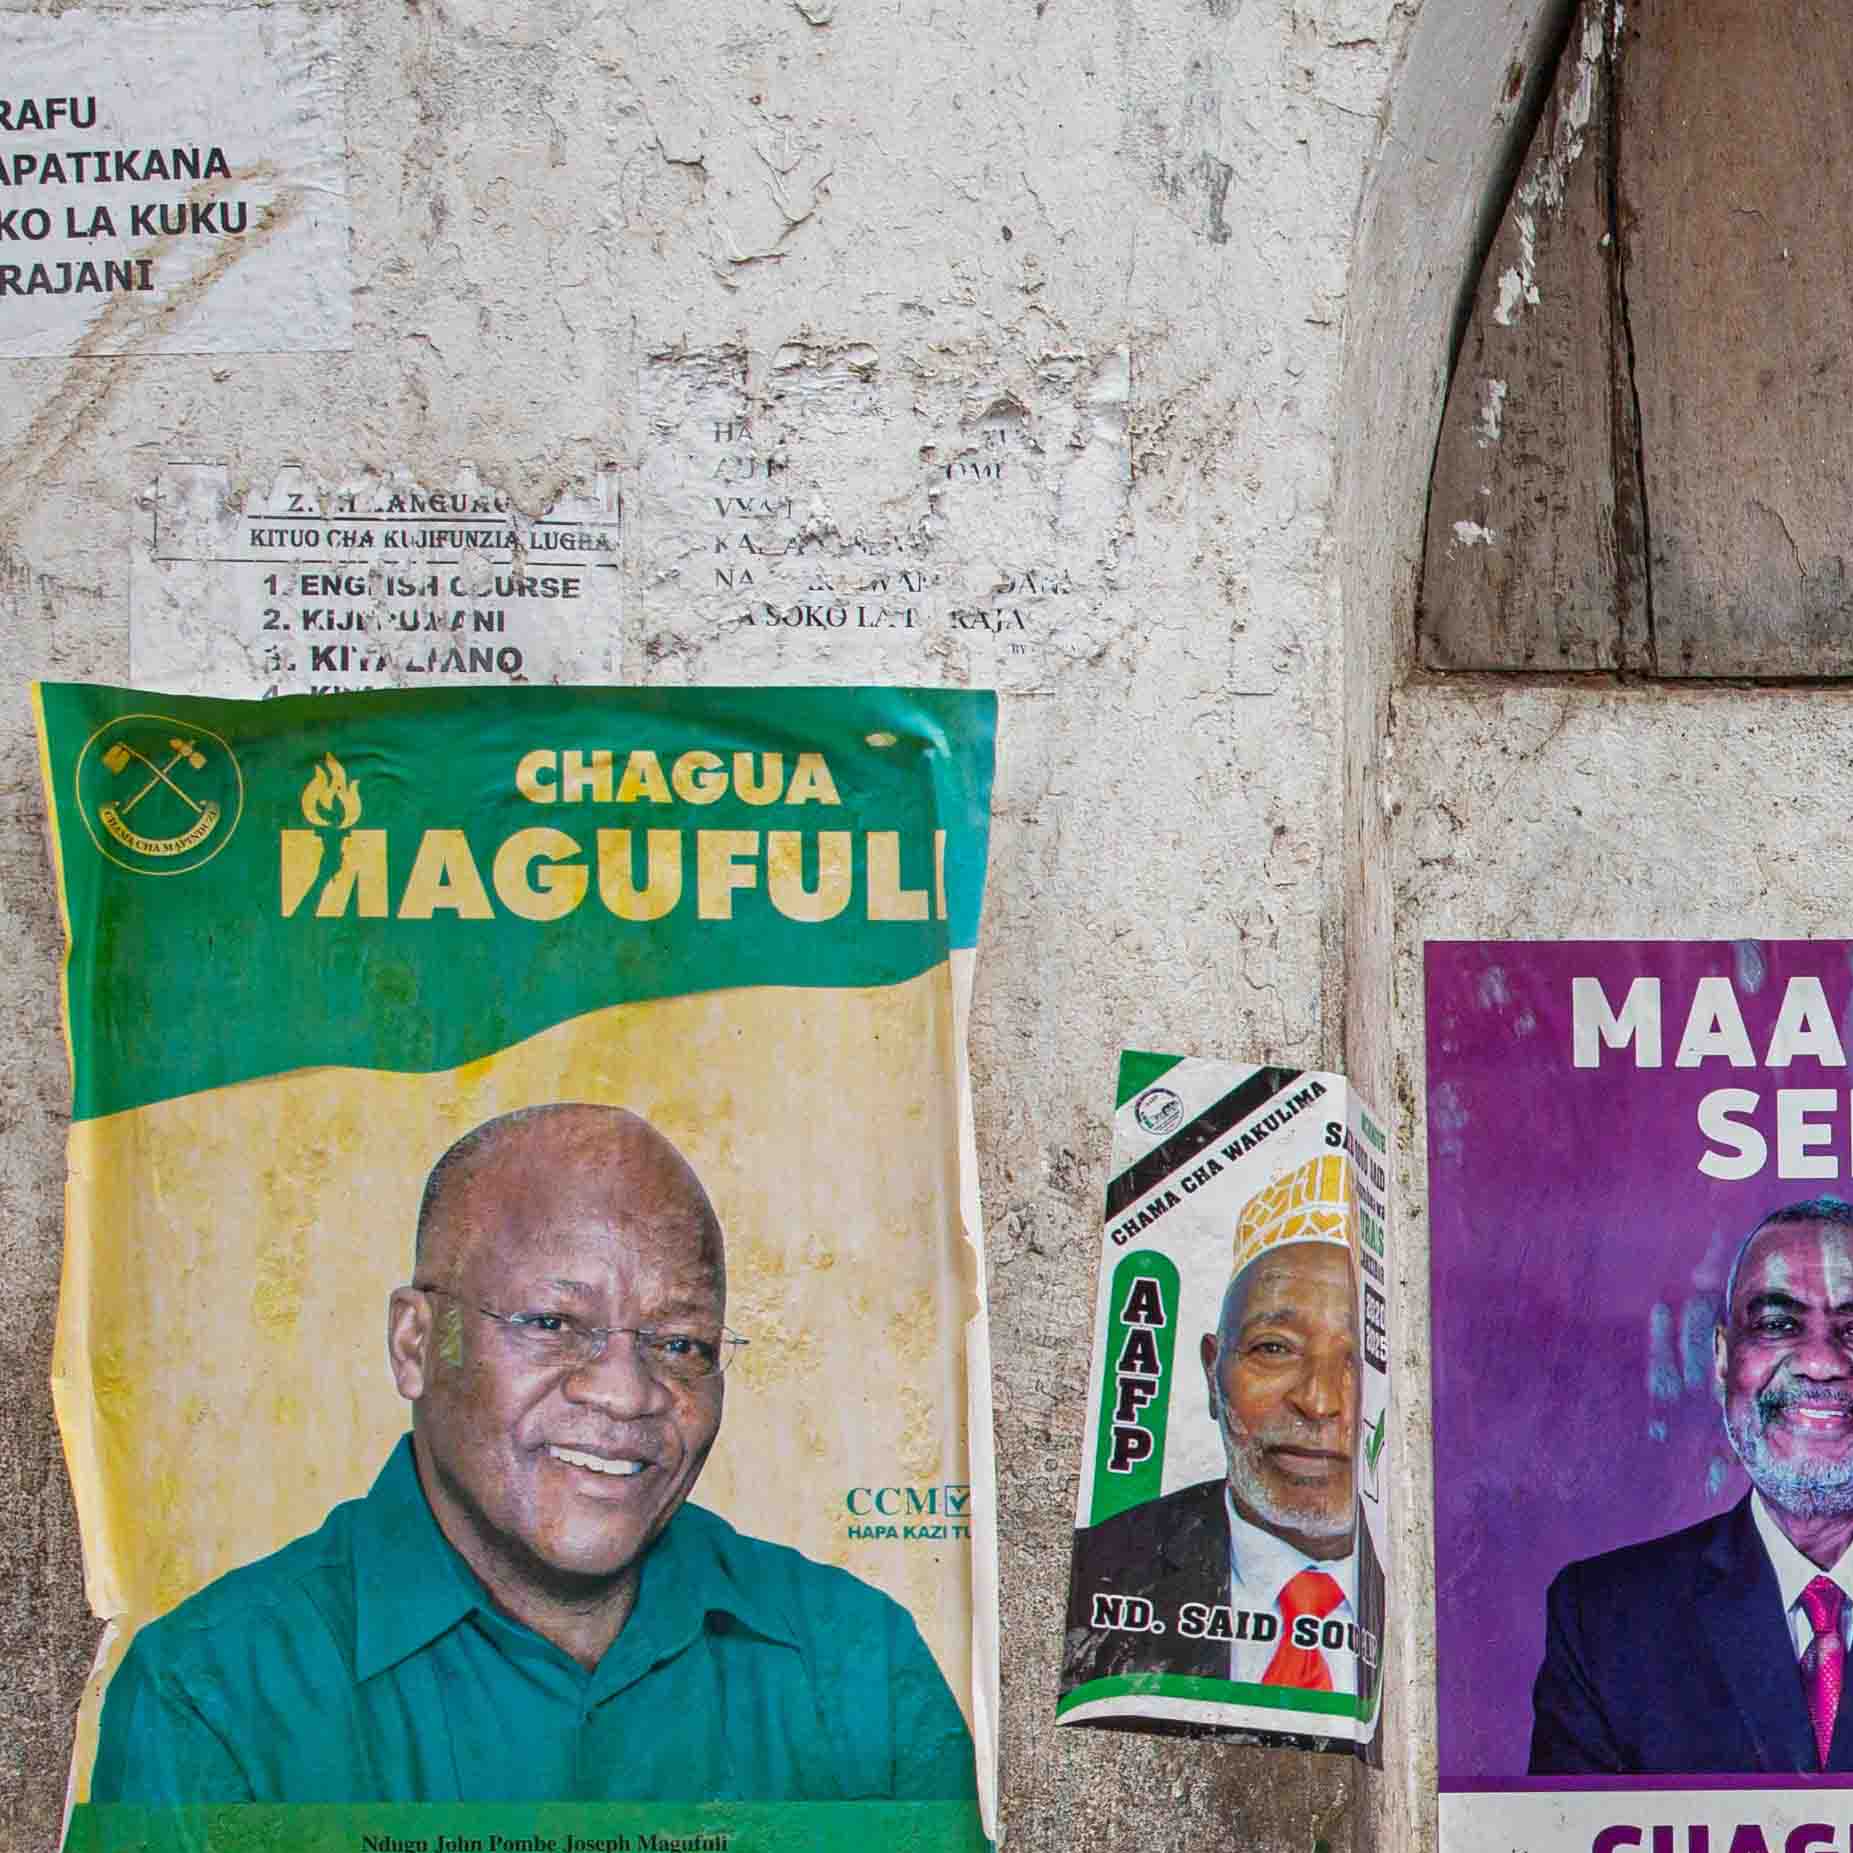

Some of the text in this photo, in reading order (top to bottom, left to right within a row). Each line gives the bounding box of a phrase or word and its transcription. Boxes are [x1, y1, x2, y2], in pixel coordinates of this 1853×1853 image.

[66, 201, 248, 239] LA KUKU
[0, 259, 154, 297] RAJANI
[249, 529, 375, 549] KITUO CHA
[515, 748, 843, 807] CHAGUA
[1110, 1186, 1182, 1248] CHAMA
[1180, 1158, 1225, 1195] CHA
[1221, 1079, 1329, 1163] WAKULIMA
[846, 1487, 938, 1516] CCM
[848, 1525, 948, 1540] HAPA KAZI
[1092, 1592, 1281, 1642] ND. SAID
[434, 1835, 482, 1853] John
[488, 1834, 557, 1853] Pombe
